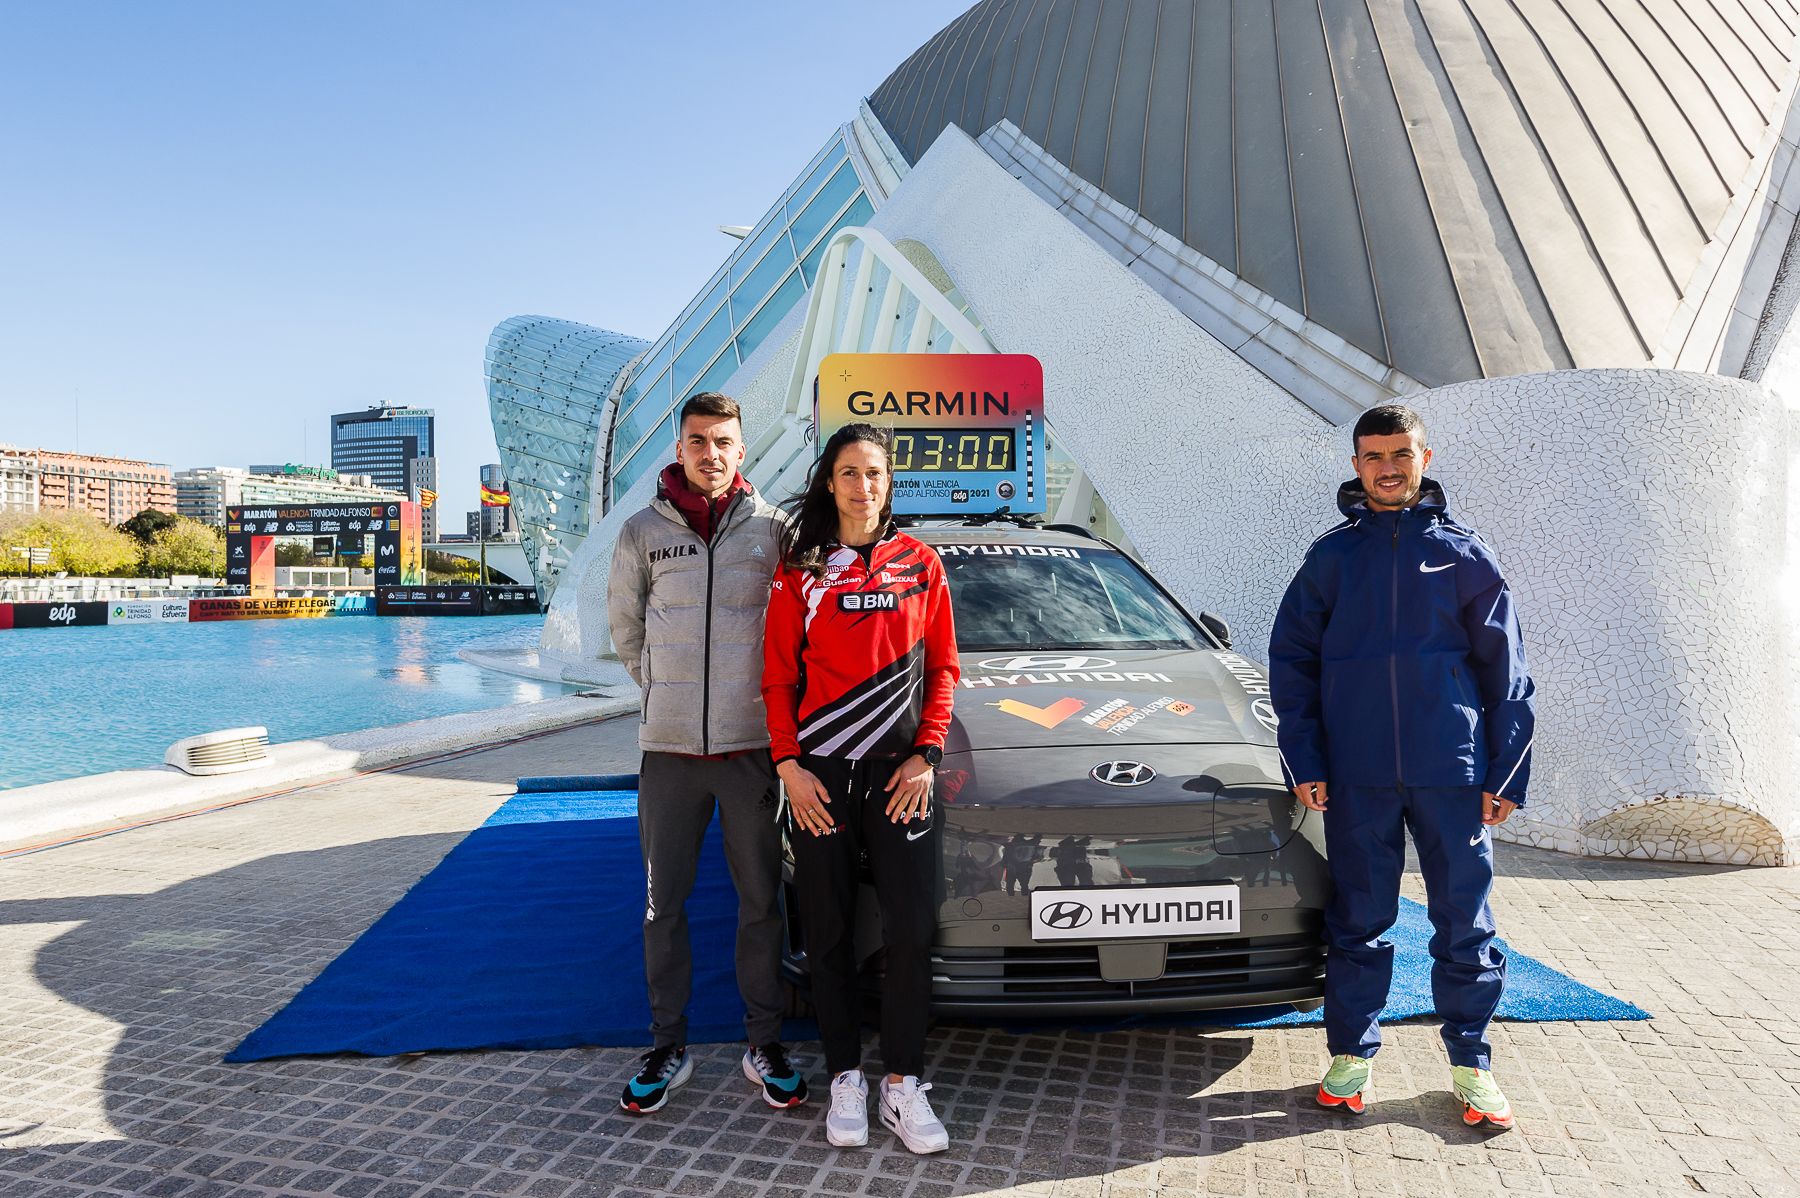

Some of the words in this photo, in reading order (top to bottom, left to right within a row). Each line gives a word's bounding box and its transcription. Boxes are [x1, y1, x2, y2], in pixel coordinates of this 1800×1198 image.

[847, 391, 1009, 416] GARMIN
[892, 435, 1010, 470] 03:00
[893, 478, 920, 488] RATÓN
[922, 480, 960, 488] VALENCIA
[893, 489, 913, 497] NIDAD
[915, 489, 950, 497] ALFONSO
[953, 491, 967, 501] edp
[243, 508, 277, 519] MARATÓN
[278, 509, 309, 518] VALENCIA
[309, 508, 339, 518] TRINIDAD
[340, 507, 371, 517] ALFONSO
[348, 520, 361, 531] edp
[649, 544, 698, 563] BIKILA
[936, 545, 1081, 559] HYUNDAI
[200, 601, 241, 610] GANAS
[244, 601, 260, 609] DE
[263, 600, 295, 609] VERTE
[299, 599, 336, 607] LLEGAR
[863, 594, 893, 609] BM
[49, 603, 77, 625] edp
[959, 671, 1174, 689] HYUNDAI
[1081, 698, 1130, 726] MARATÓN
[1094, 705, 1138, 730] VALENCIA
[1101, 900, 1233, 925] HYUNDAI
